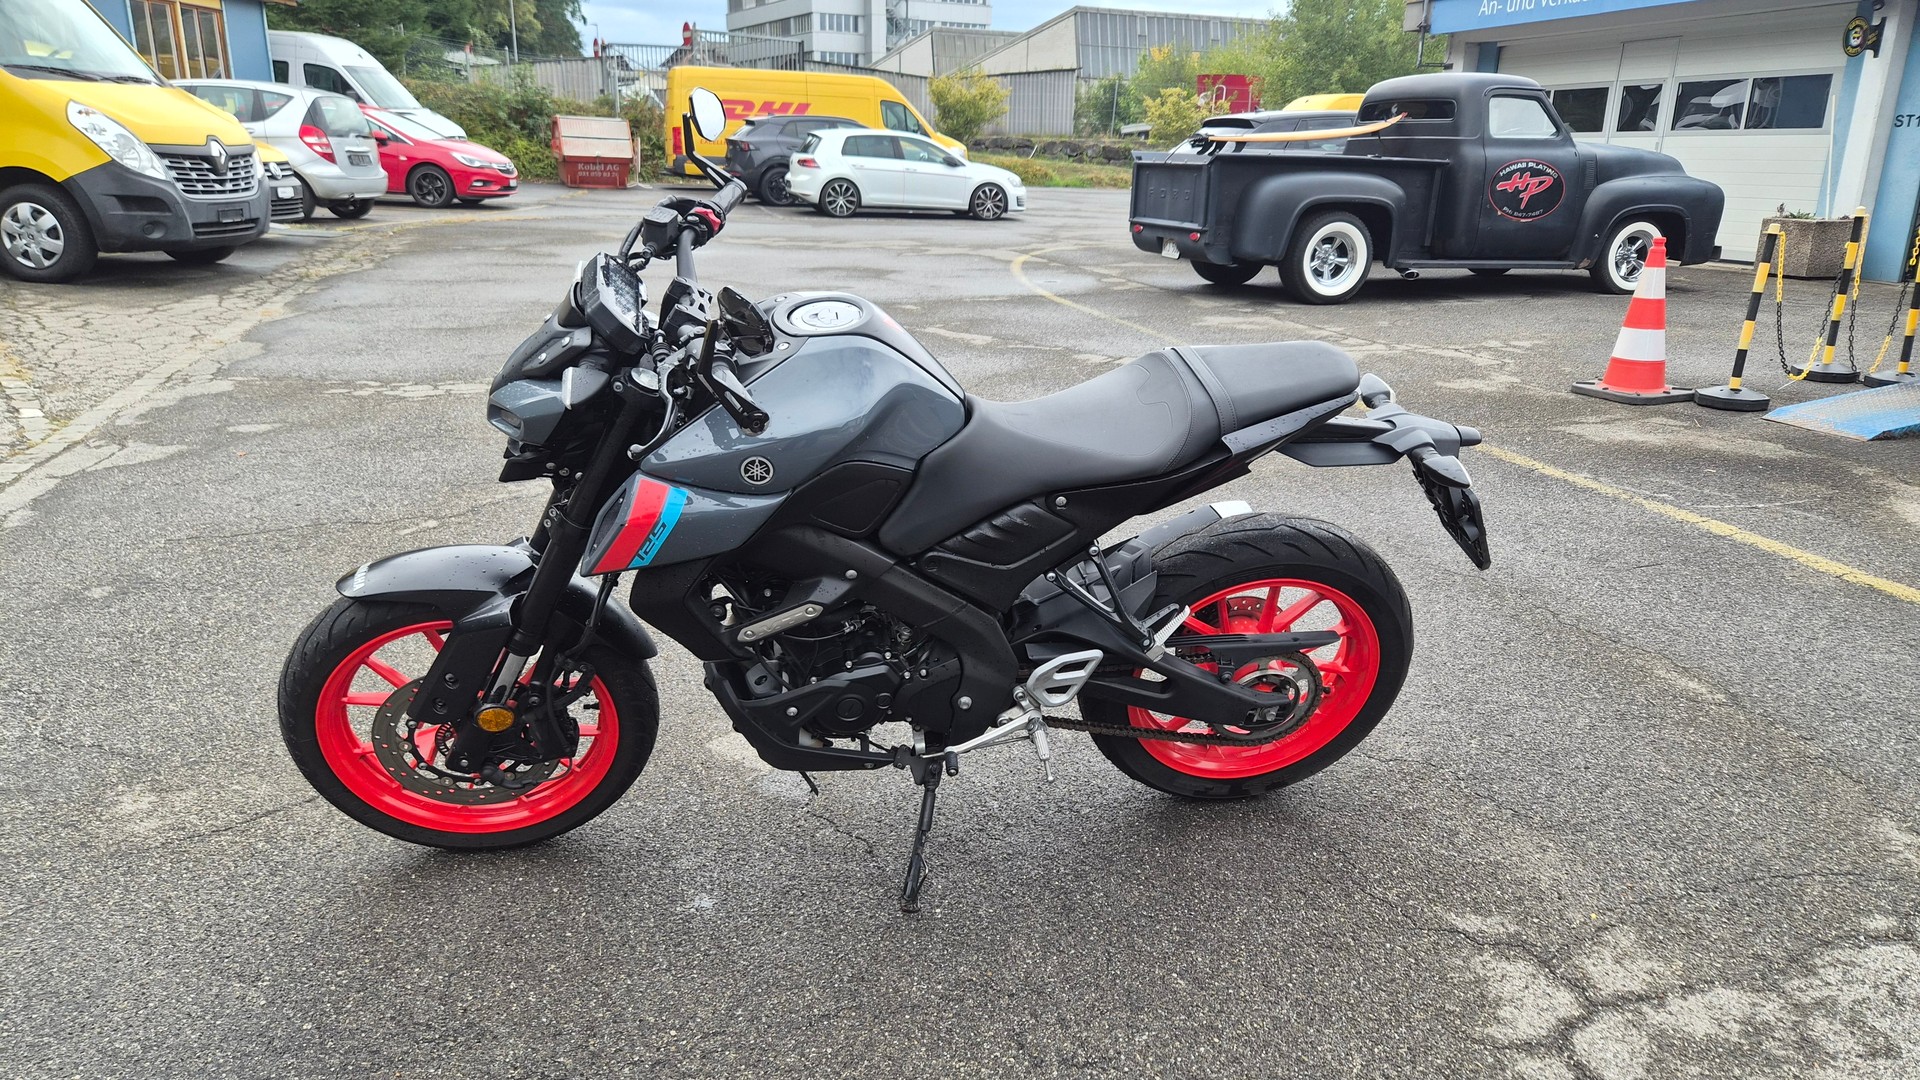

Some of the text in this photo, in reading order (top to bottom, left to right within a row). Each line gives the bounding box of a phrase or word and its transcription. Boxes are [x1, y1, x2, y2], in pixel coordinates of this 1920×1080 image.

[1478, 0, 1503, 16] An-
[722, 99, 811, 120] DHL
[578, 163, 604, 171] Kobel
[1499, 162, 1559, 179] HAWAII PLATING
[1148, 186, 1191, 201] FORD
[1496, 171, 1554, 209] HP
[635, 521, 667, 562] 125
